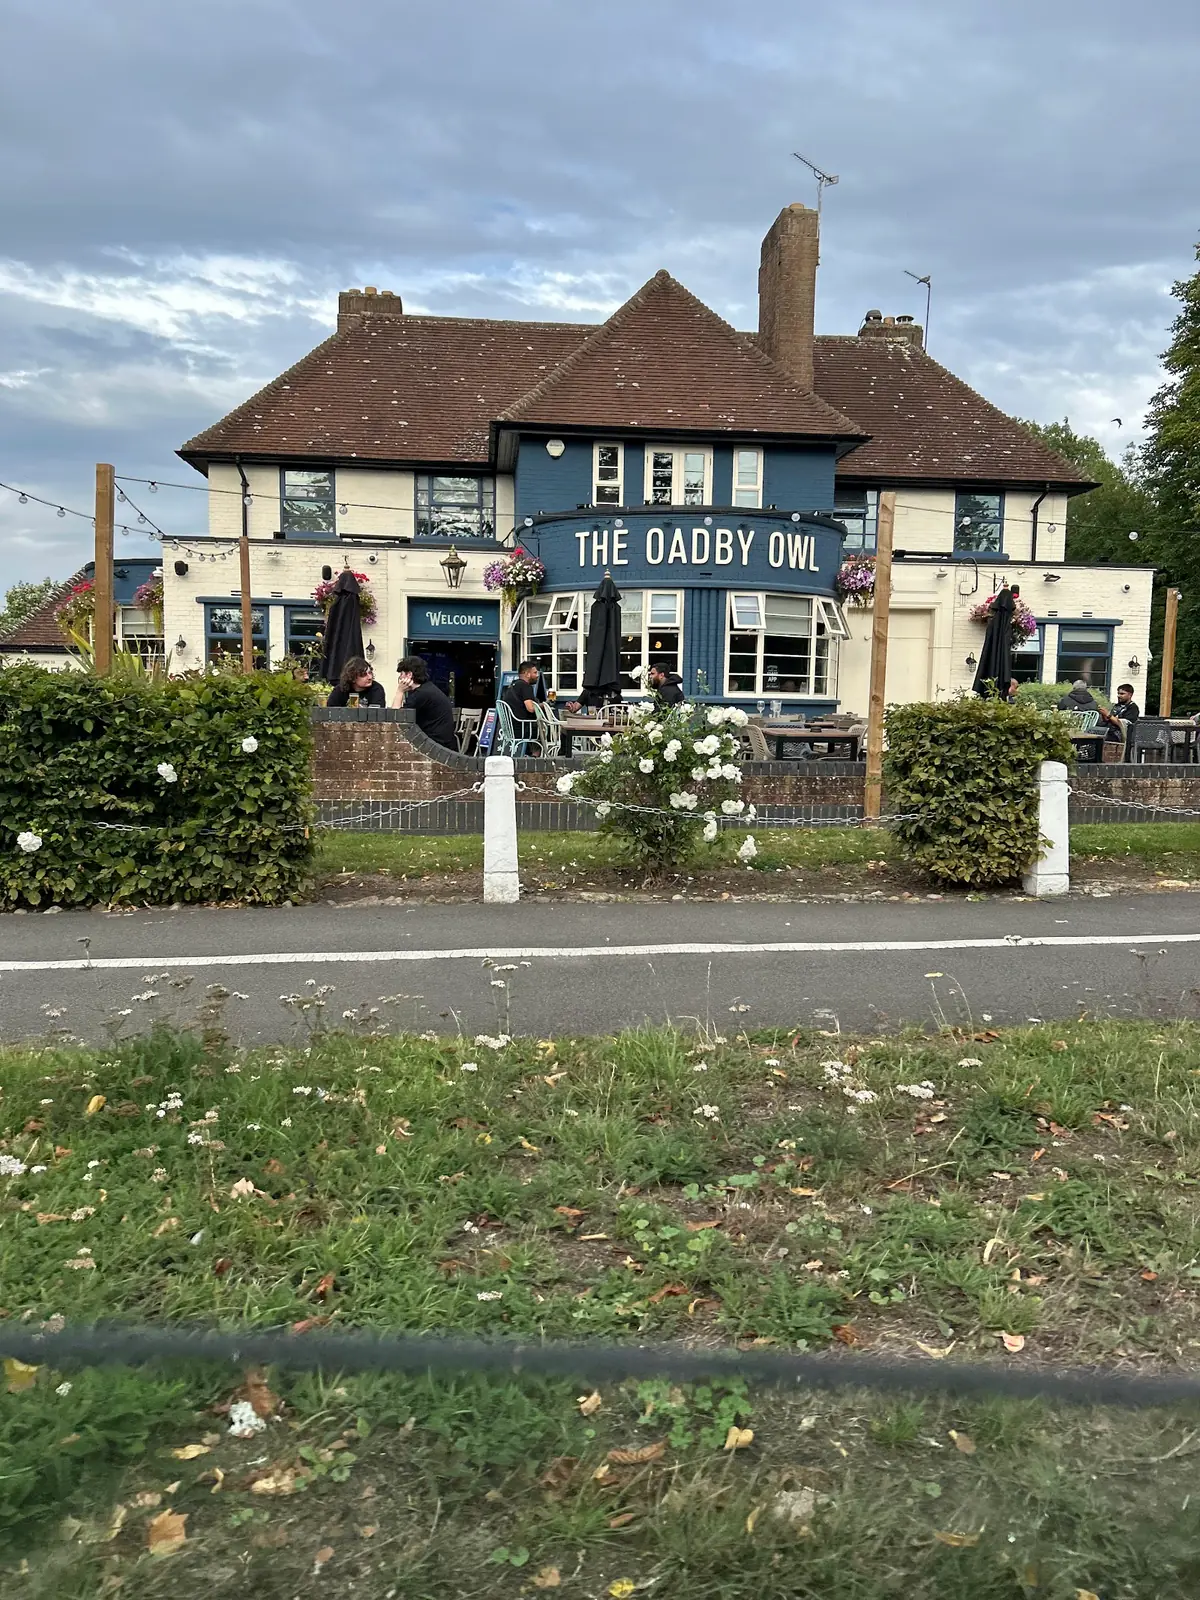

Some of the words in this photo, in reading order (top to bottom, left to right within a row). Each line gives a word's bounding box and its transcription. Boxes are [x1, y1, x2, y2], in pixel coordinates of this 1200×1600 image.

[575, 529, 629, 567] THE
[646, 527, 755, 566] OADBY
[768, 531, 819, 572] OWL
